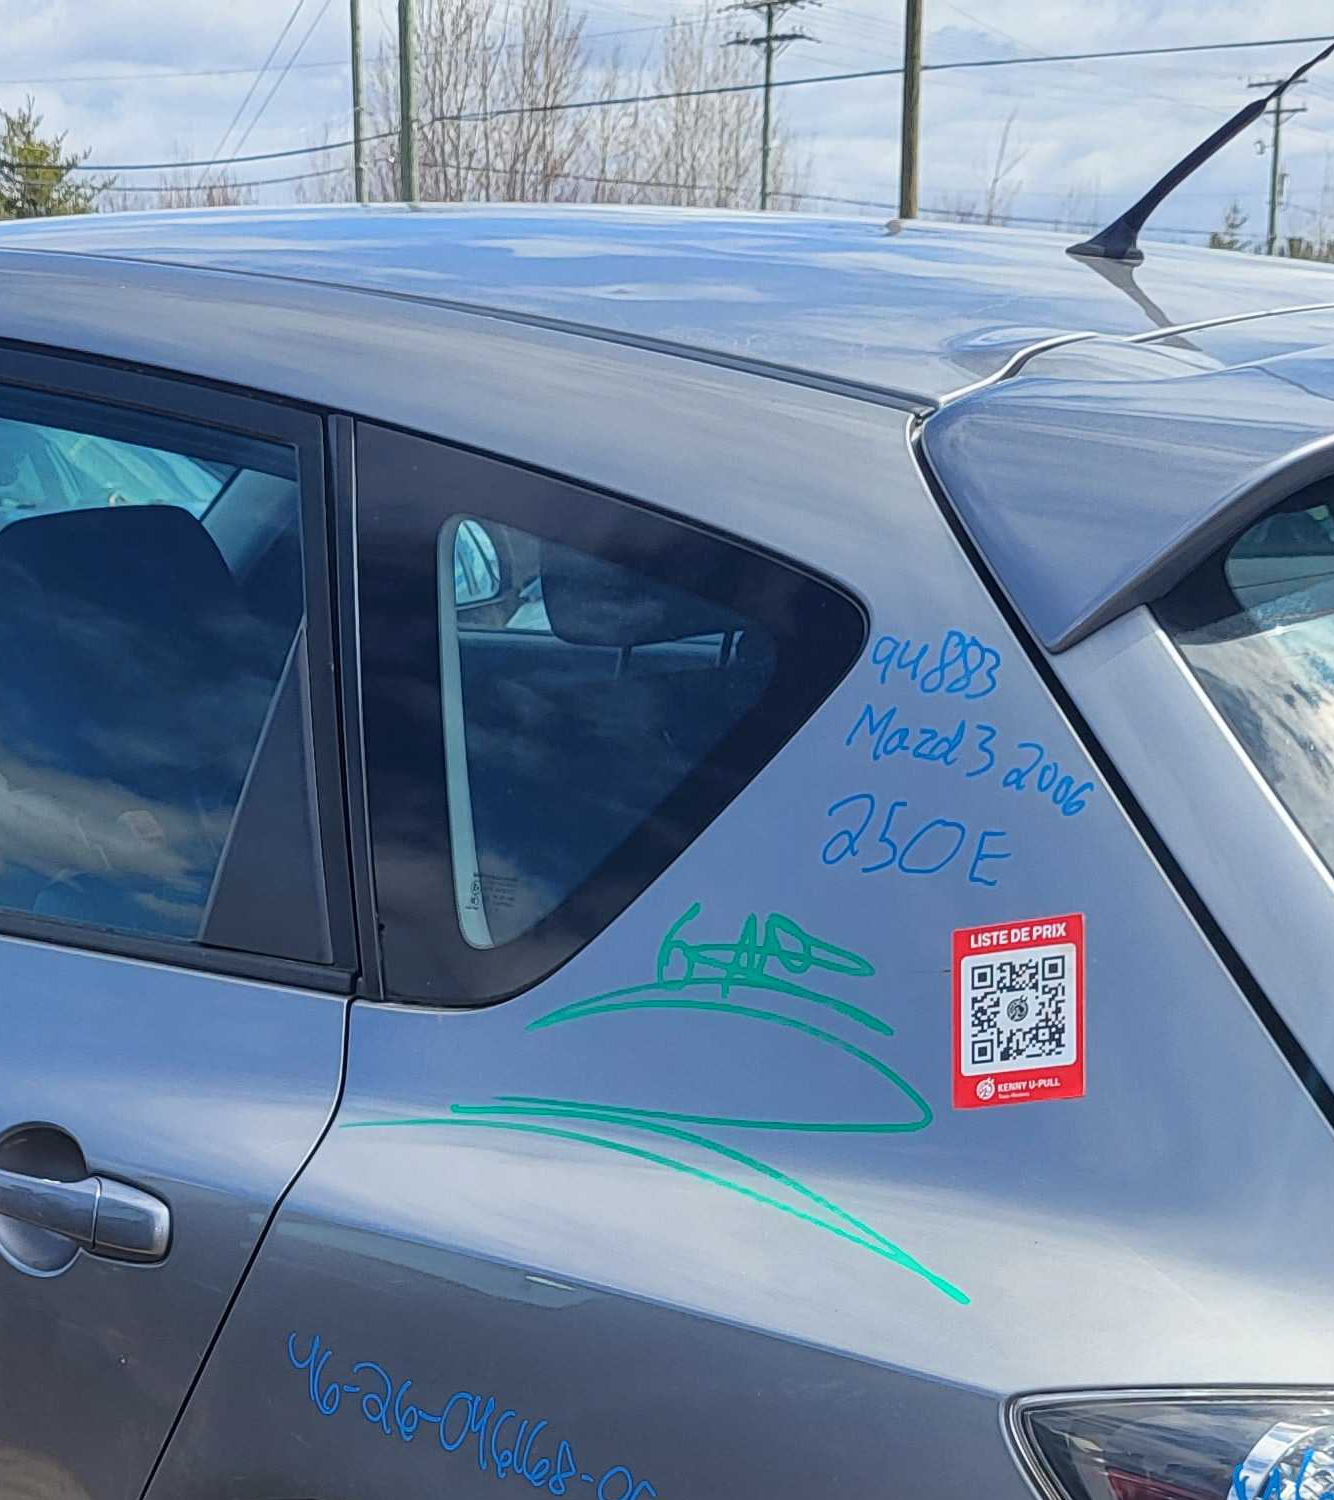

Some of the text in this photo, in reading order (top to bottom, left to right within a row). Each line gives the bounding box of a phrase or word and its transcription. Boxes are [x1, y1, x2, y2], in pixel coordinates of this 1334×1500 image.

[872, 630, 1001, 698] 94883
[1002, 742, 1095, 816] 2006
[970, 922, 1066, 948] LISTE DE PRIX
[1028, 1077, 1061, 1090] U-PULL
